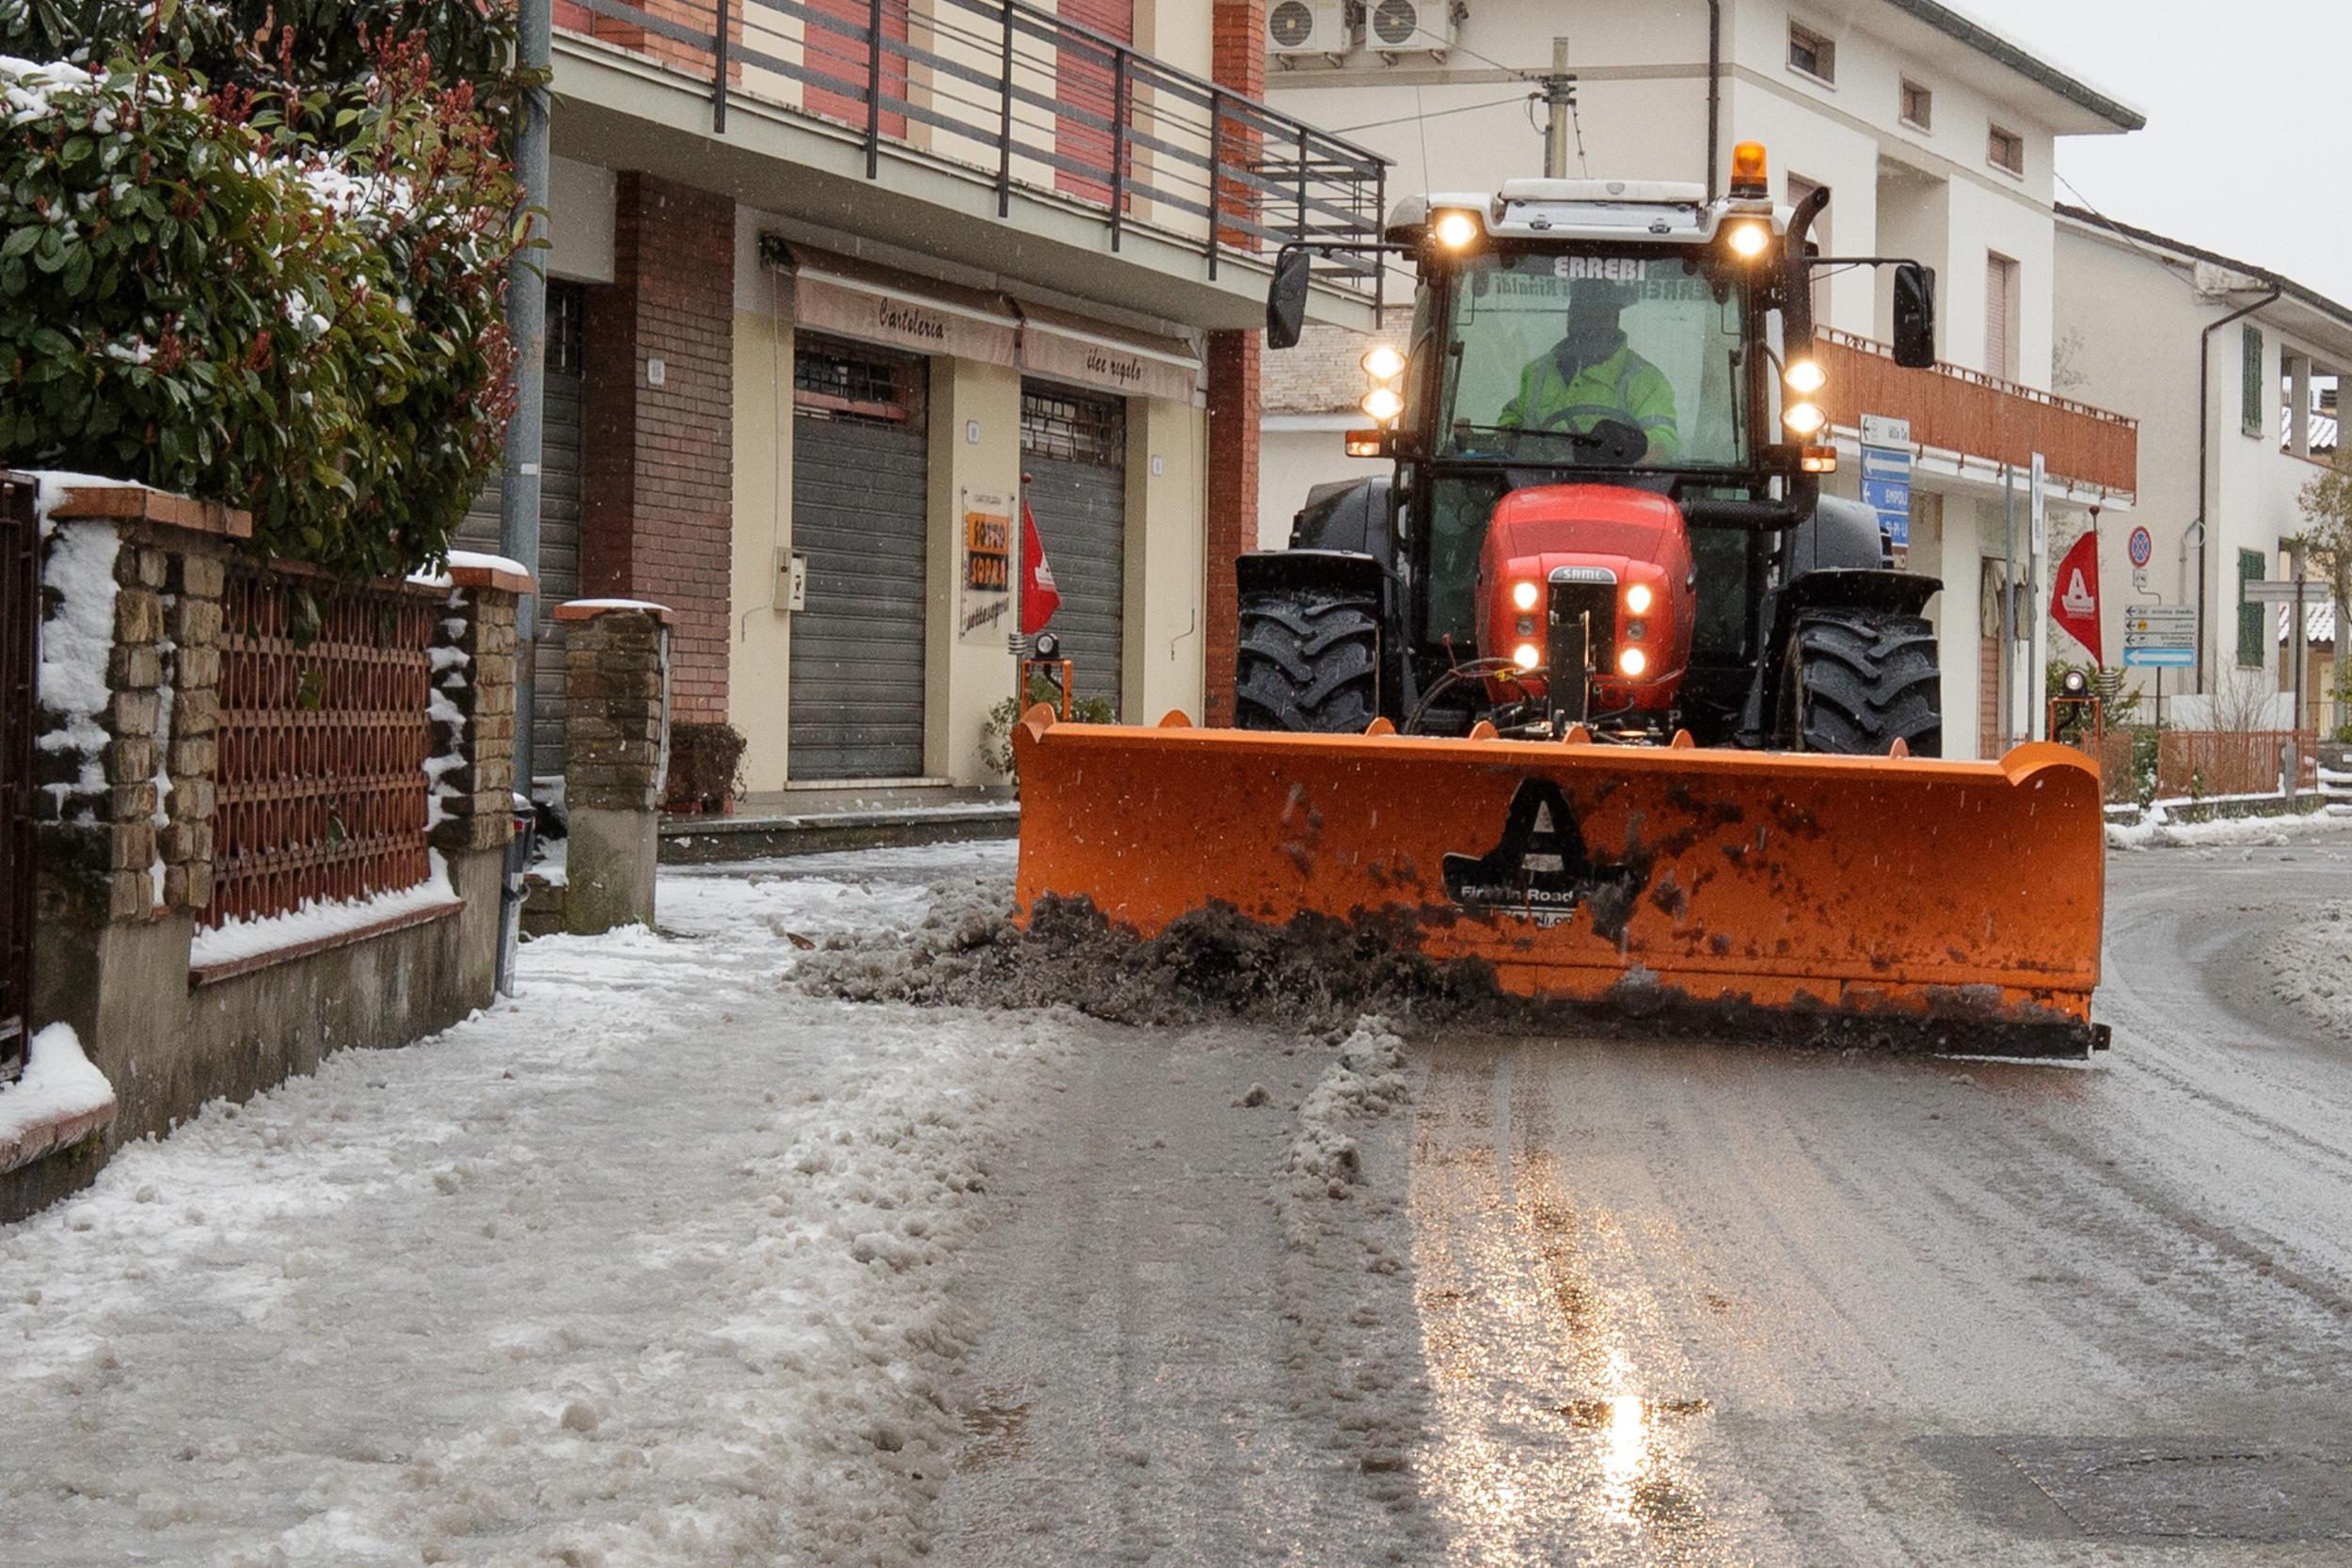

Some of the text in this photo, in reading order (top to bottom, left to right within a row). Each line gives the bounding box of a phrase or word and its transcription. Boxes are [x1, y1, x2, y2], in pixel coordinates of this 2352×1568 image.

[1554, 256, 1645, 280] ERREBI
[879, 296, 944, 339] Cartoleria
[1087, 347, 1141, 385] idee regalo
[971, 556, 1006, 587] SOPRA
[1564, 568, 1601, 581] SAME
[1527, 889, 1574, 902] Road
